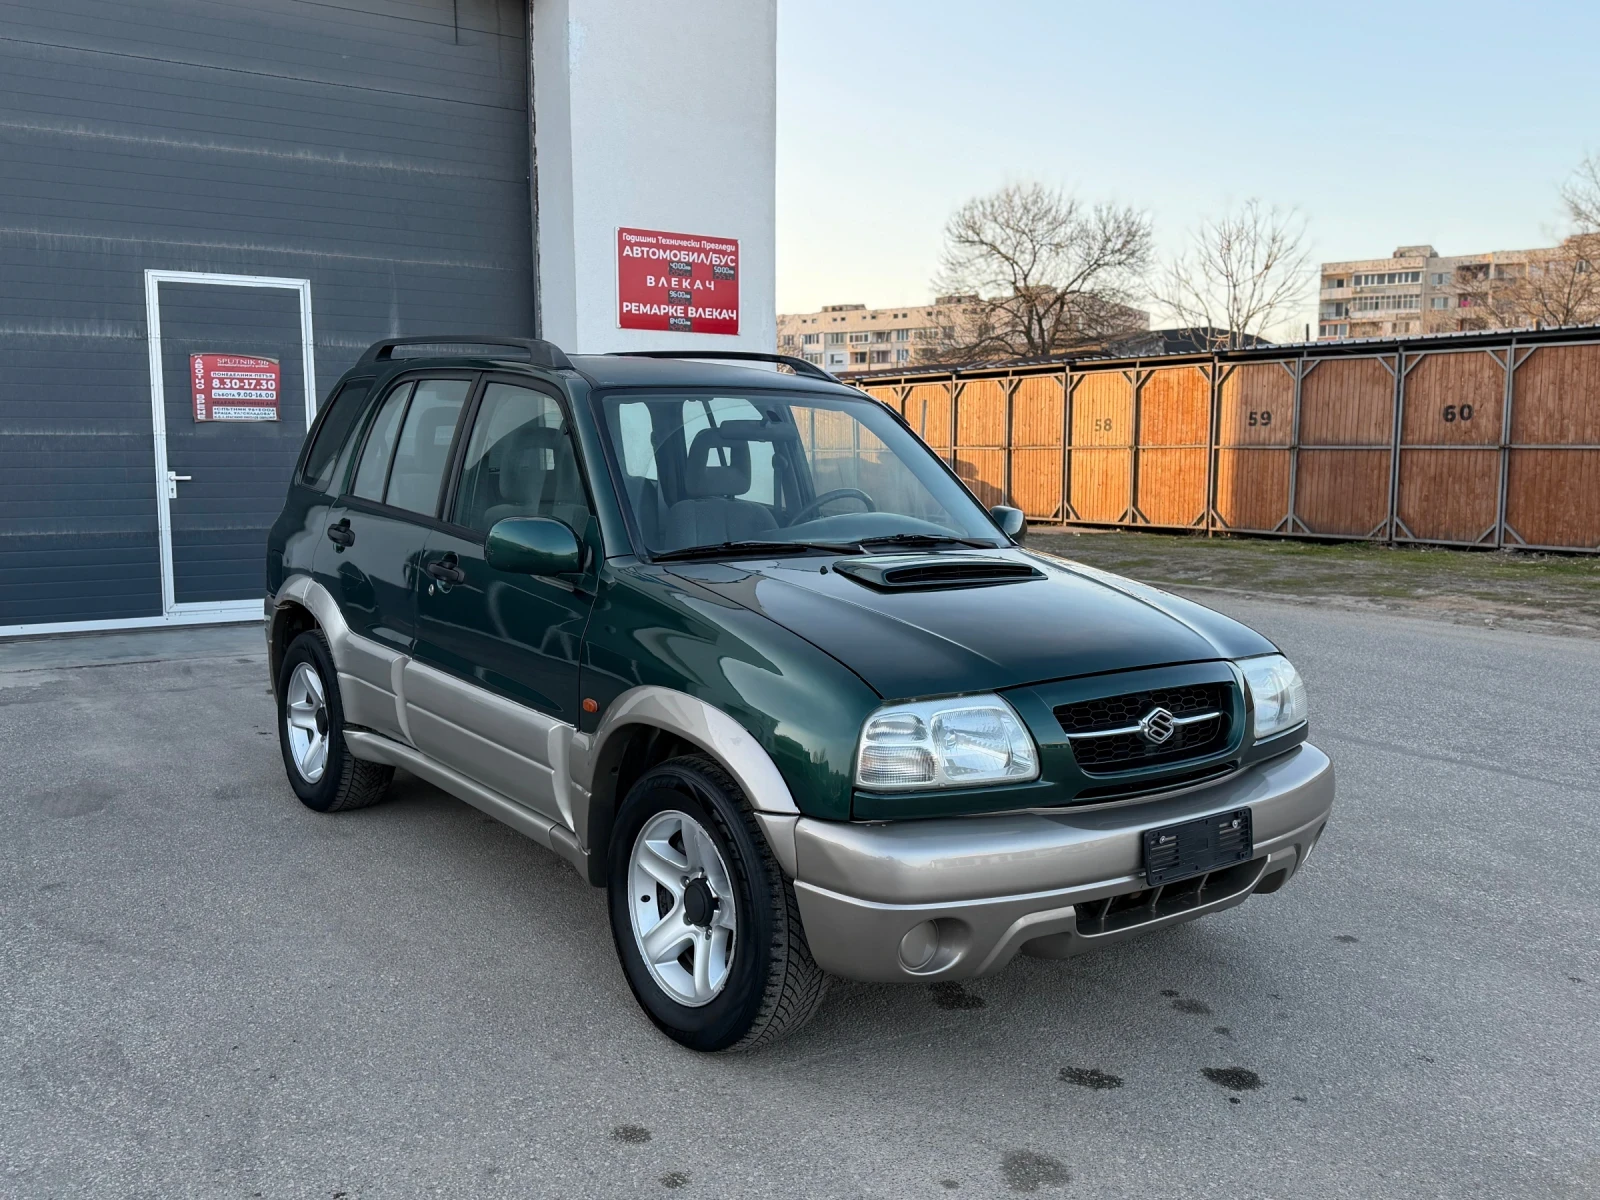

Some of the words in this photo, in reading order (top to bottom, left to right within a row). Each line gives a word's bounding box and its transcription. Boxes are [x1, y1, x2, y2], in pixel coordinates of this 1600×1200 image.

[622, 233, 657, 243] Годишни
[657, 236, 700, 248] Технически
[701, 241, 736, 252] Прегледи
[622, 246, 736, 266] АВТОМОБИЛ/БУС
[622, 302, 685, 317] РЕМАРКЕ
[688, 306, 737, 320] ВЛЕКАЧ
[212, 378, 276, 390] 8.30-17.30
[1248, 410, 1272, 427] 59
[1442, 404, 1473, 423] 60
[1094, 417, 1112, 432] 58
